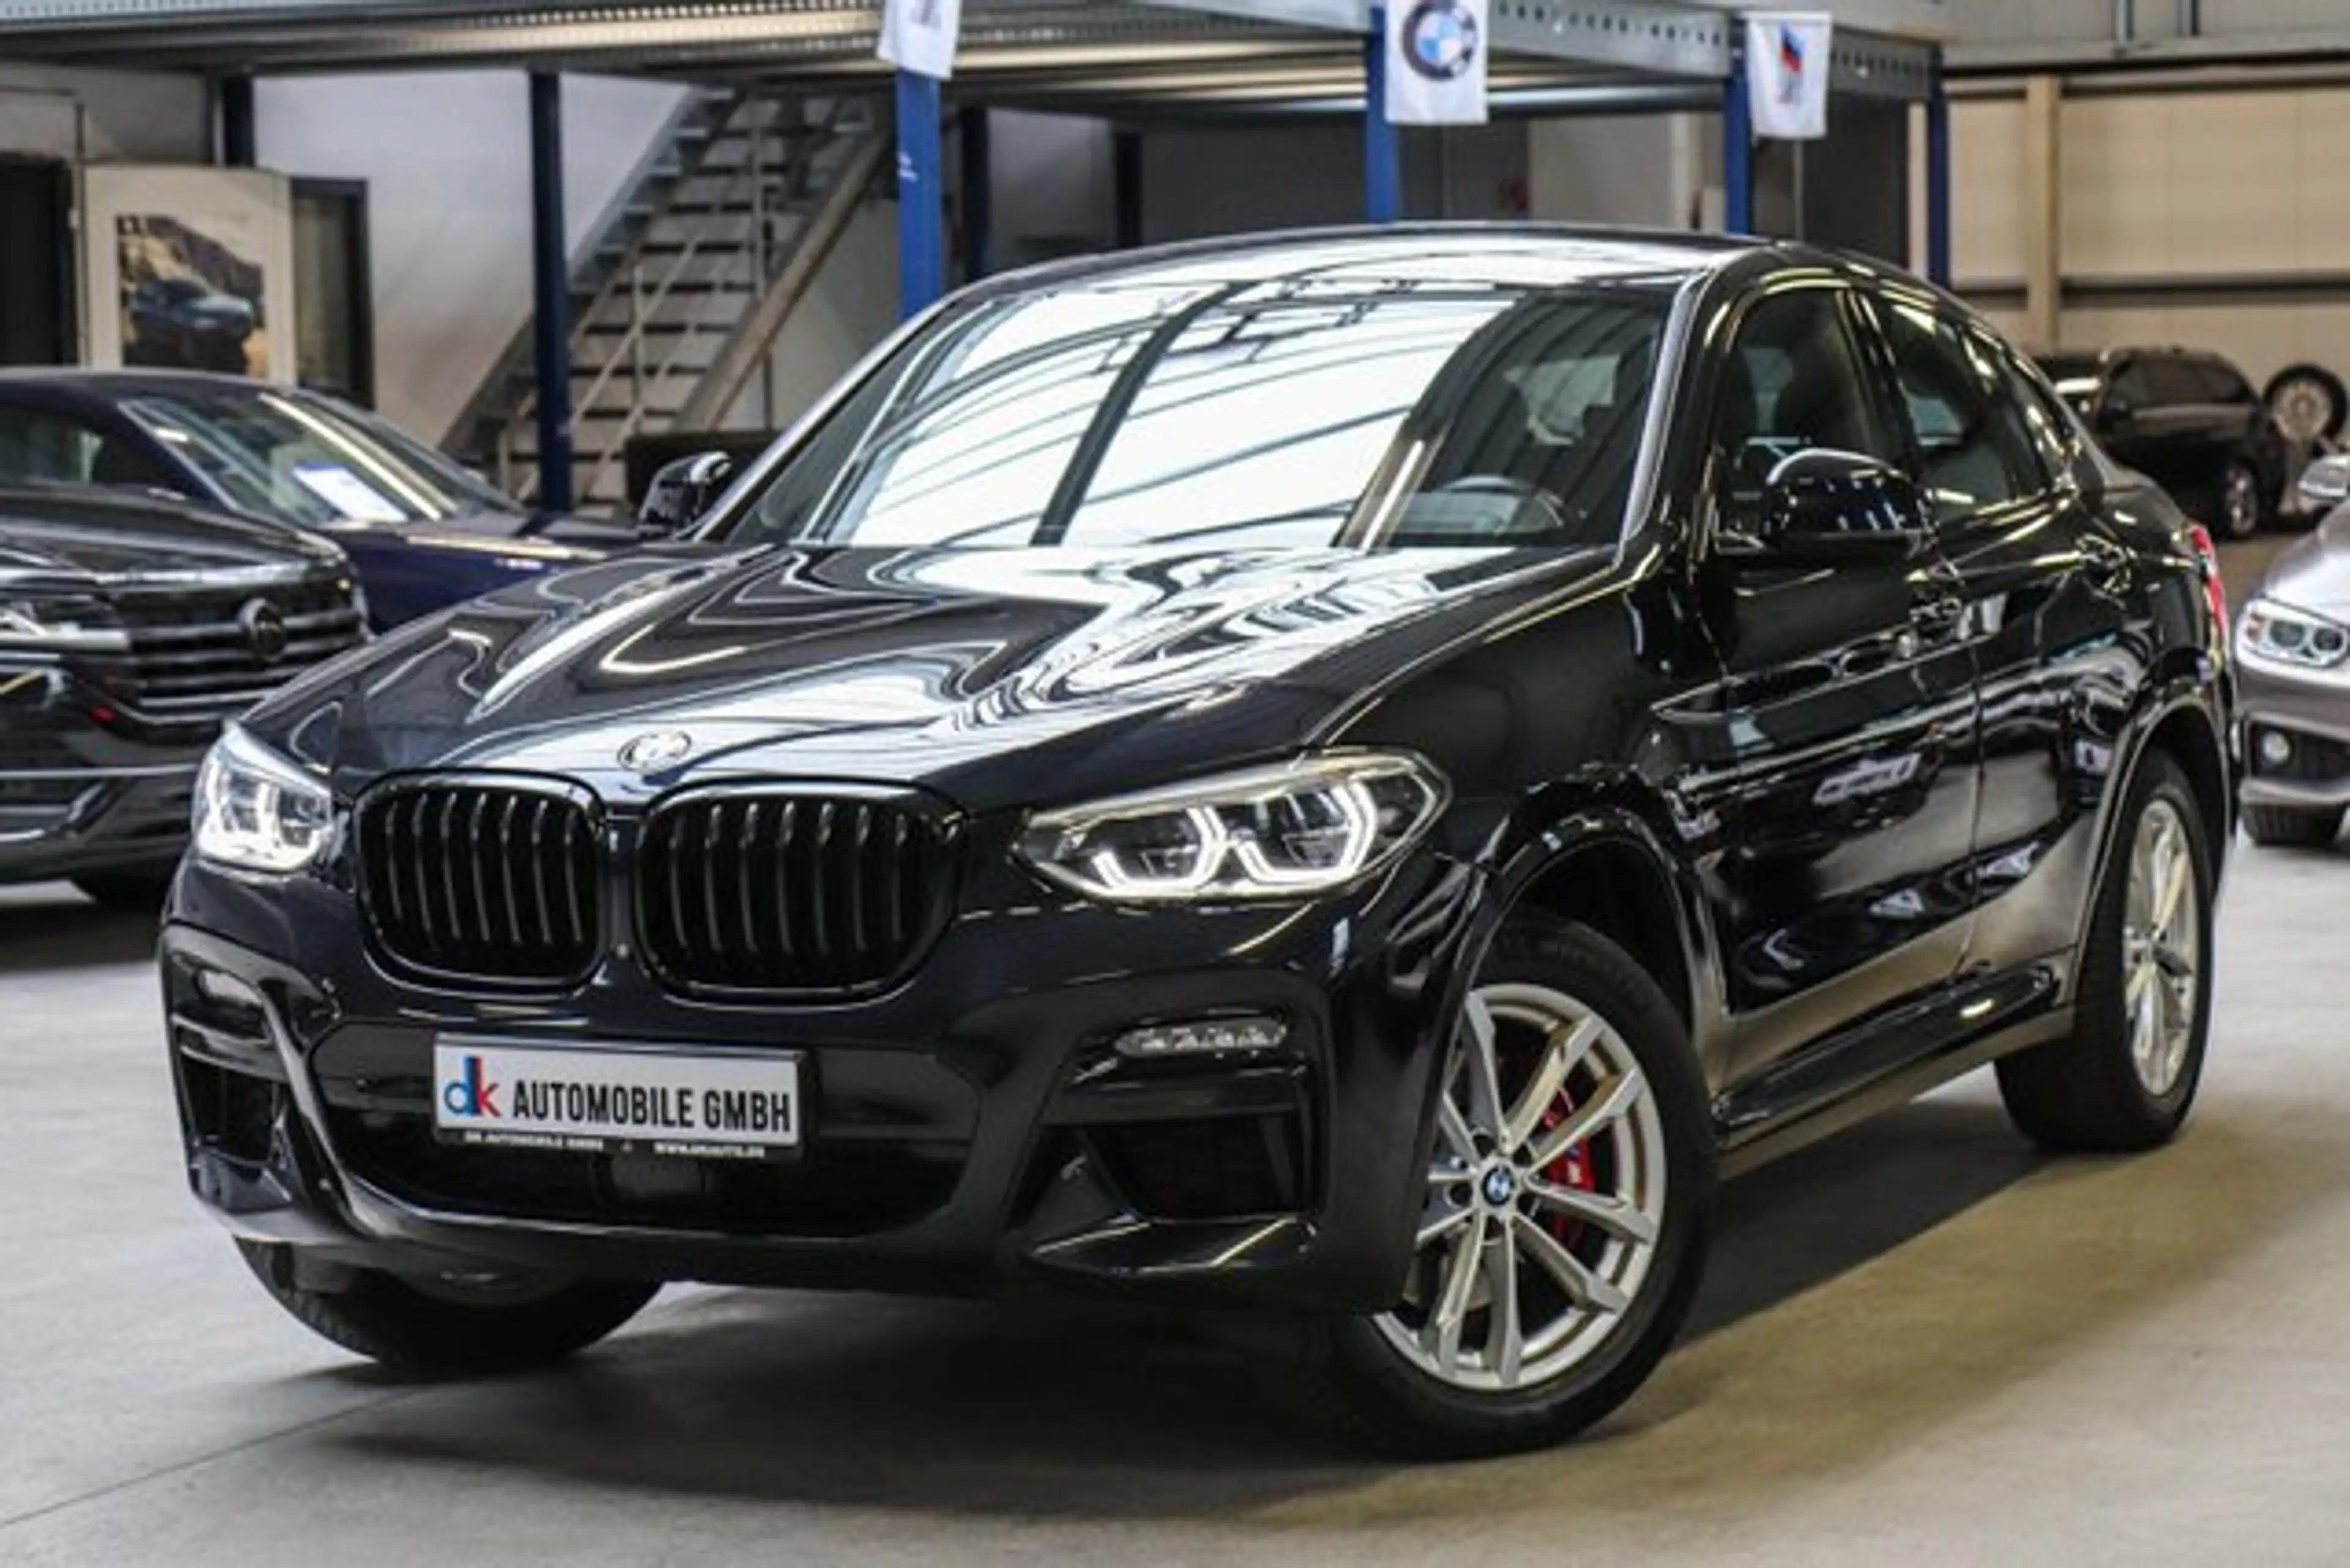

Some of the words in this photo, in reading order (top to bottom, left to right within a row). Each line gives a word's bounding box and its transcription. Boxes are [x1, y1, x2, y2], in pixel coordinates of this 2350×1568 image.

[444, 1055, 501, 1117] dk
[513, 1077, 695, 1129] AUTOMOBILE
[703, 1088, 791, 1133] GMBH
